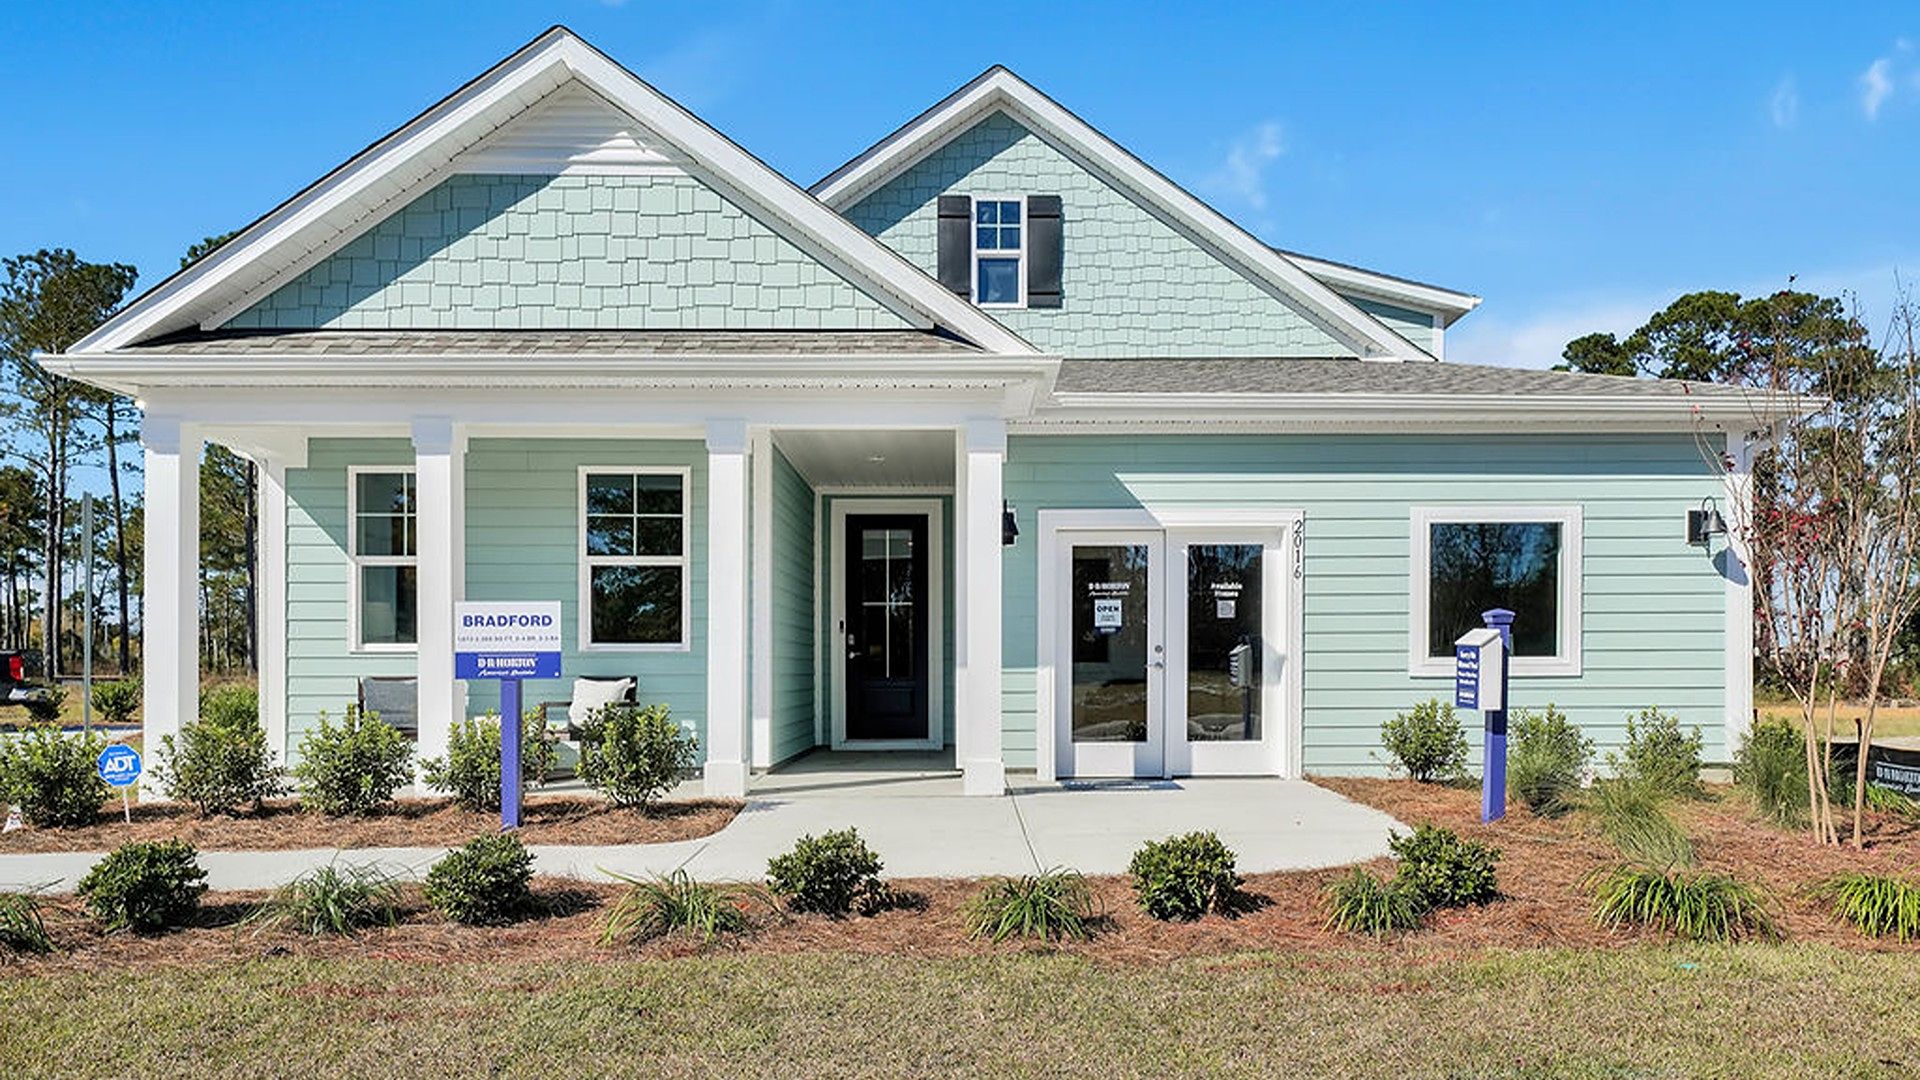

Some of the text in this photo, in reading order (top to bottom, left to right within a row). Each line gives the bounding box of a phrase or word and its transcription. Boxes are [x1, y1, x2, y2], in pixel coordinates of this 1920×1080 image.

[1293, 519, 1303, 579] 2016
[463, 615, 553, 627] BRADFORD
[103, 755, 137, 773] ADT
